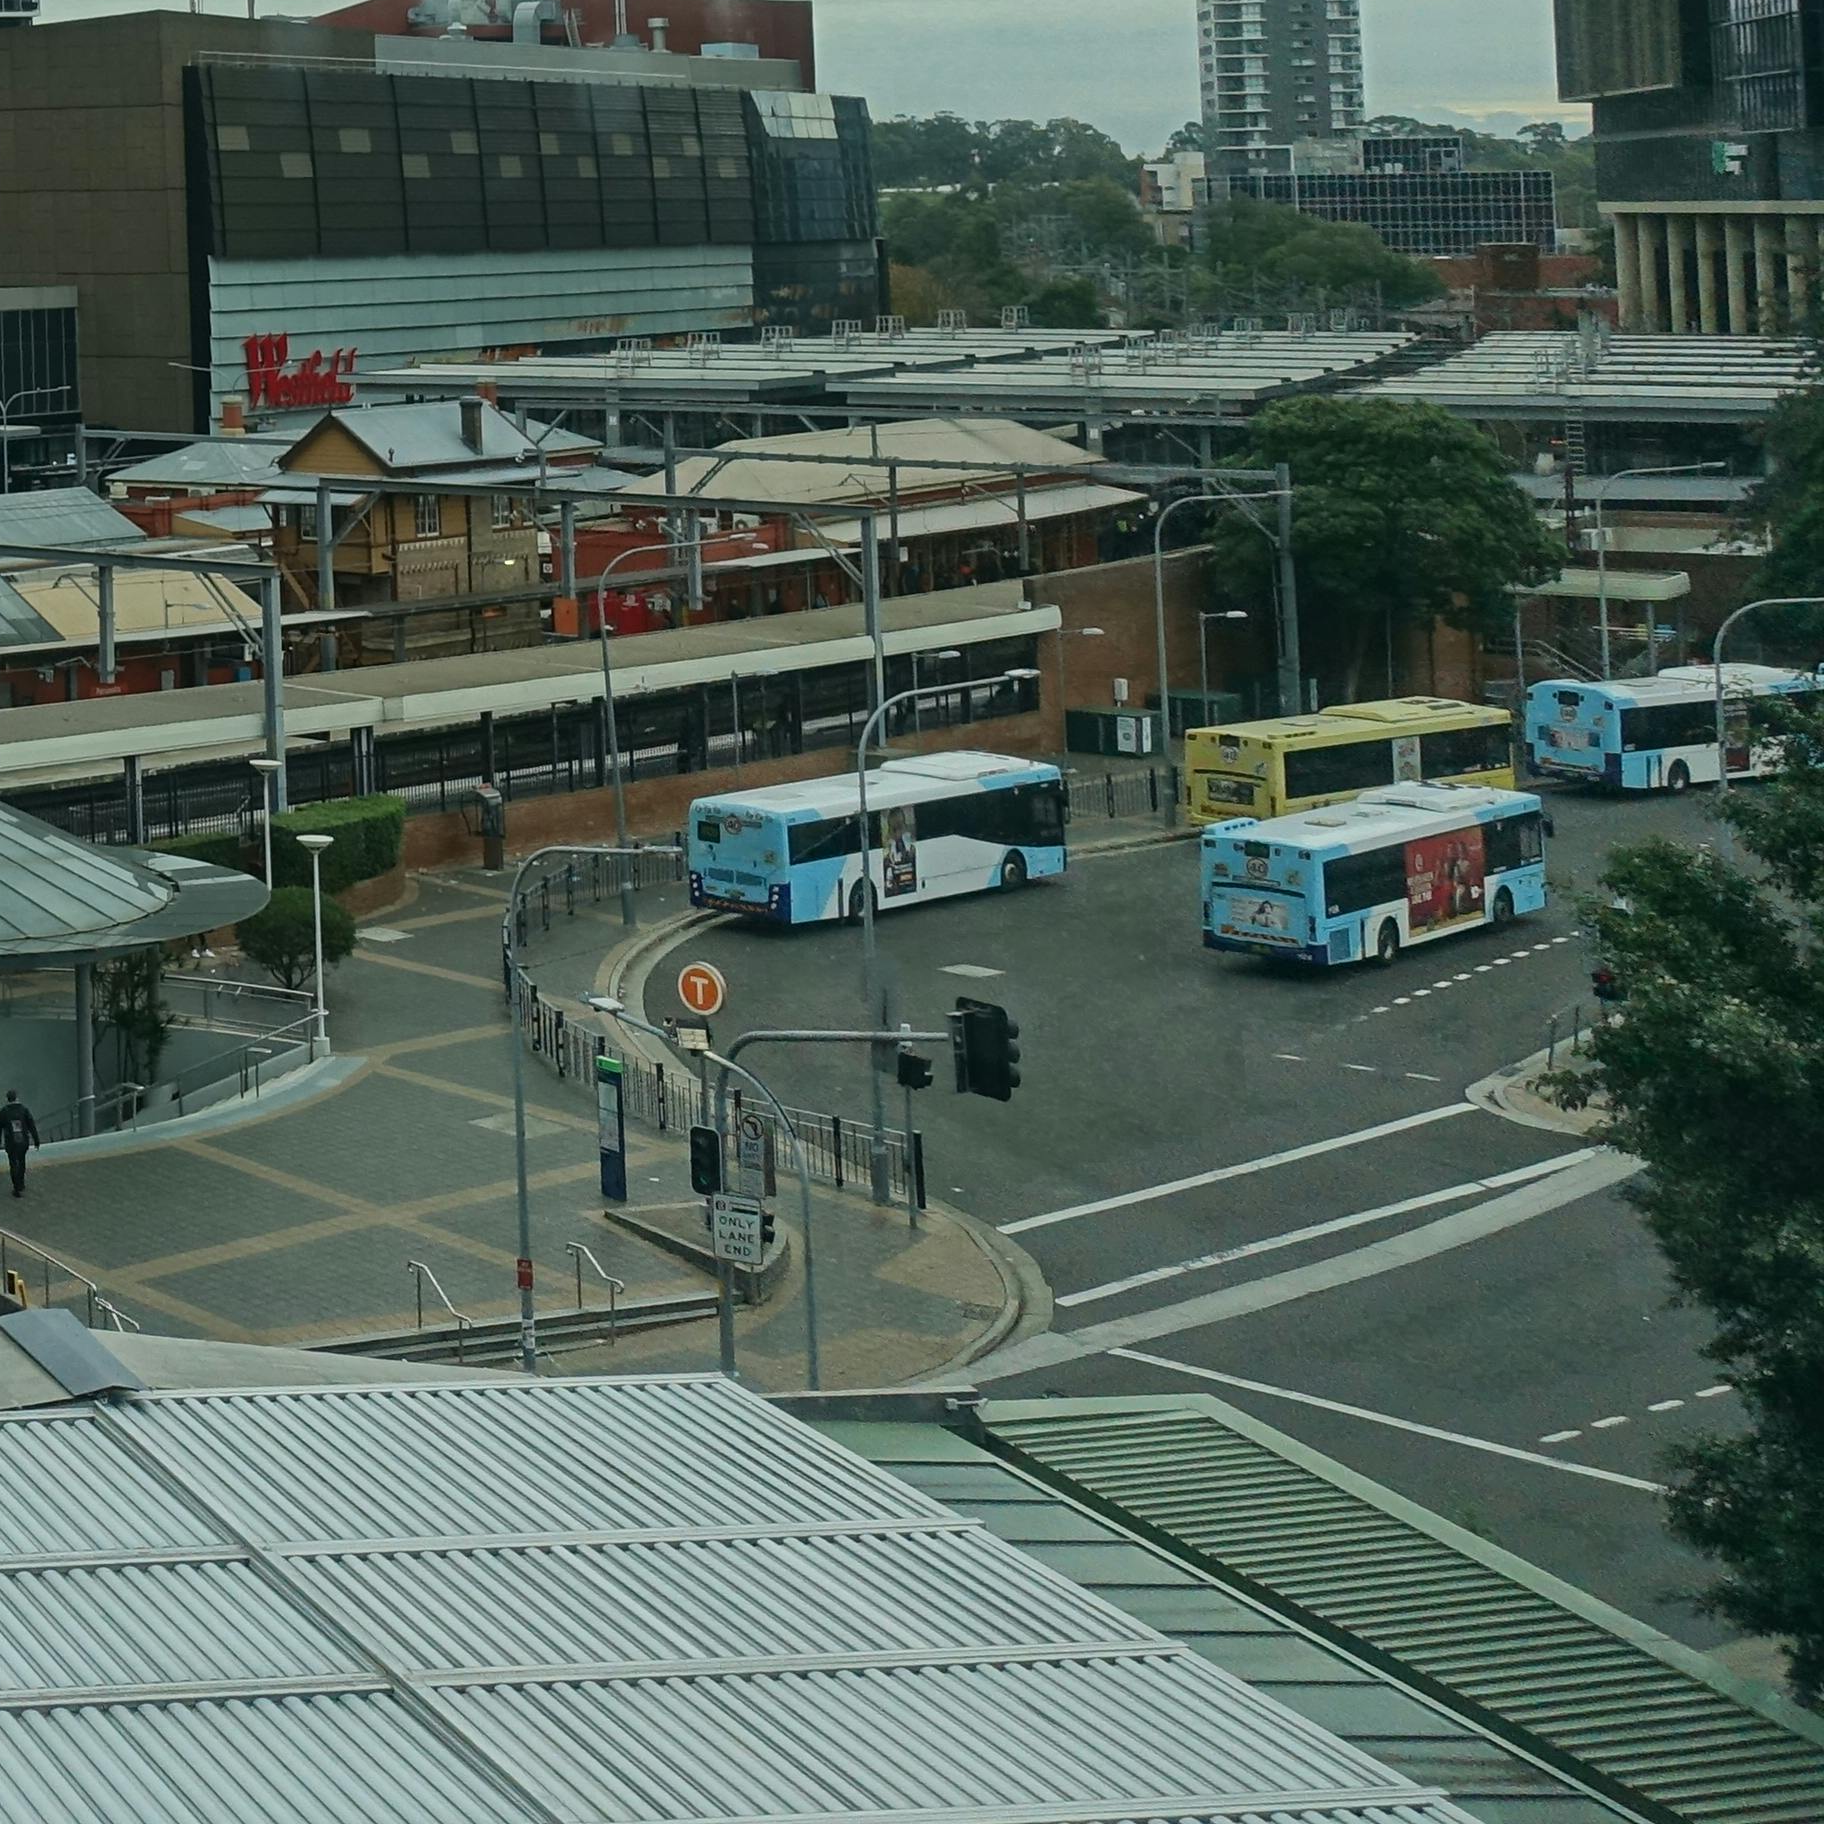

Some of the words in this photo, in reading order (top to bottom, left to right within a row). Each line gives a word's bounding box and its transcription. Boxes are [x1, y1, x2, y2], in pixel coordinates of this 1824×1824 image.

[241, 332, 357, 410] Westfield
[690, 975, 709, 1005] T
[719, 1216, 755, 1229] ONLY
[718, 1229, 754, 1244] LANE
[724, 1244, 751, 1256] END
